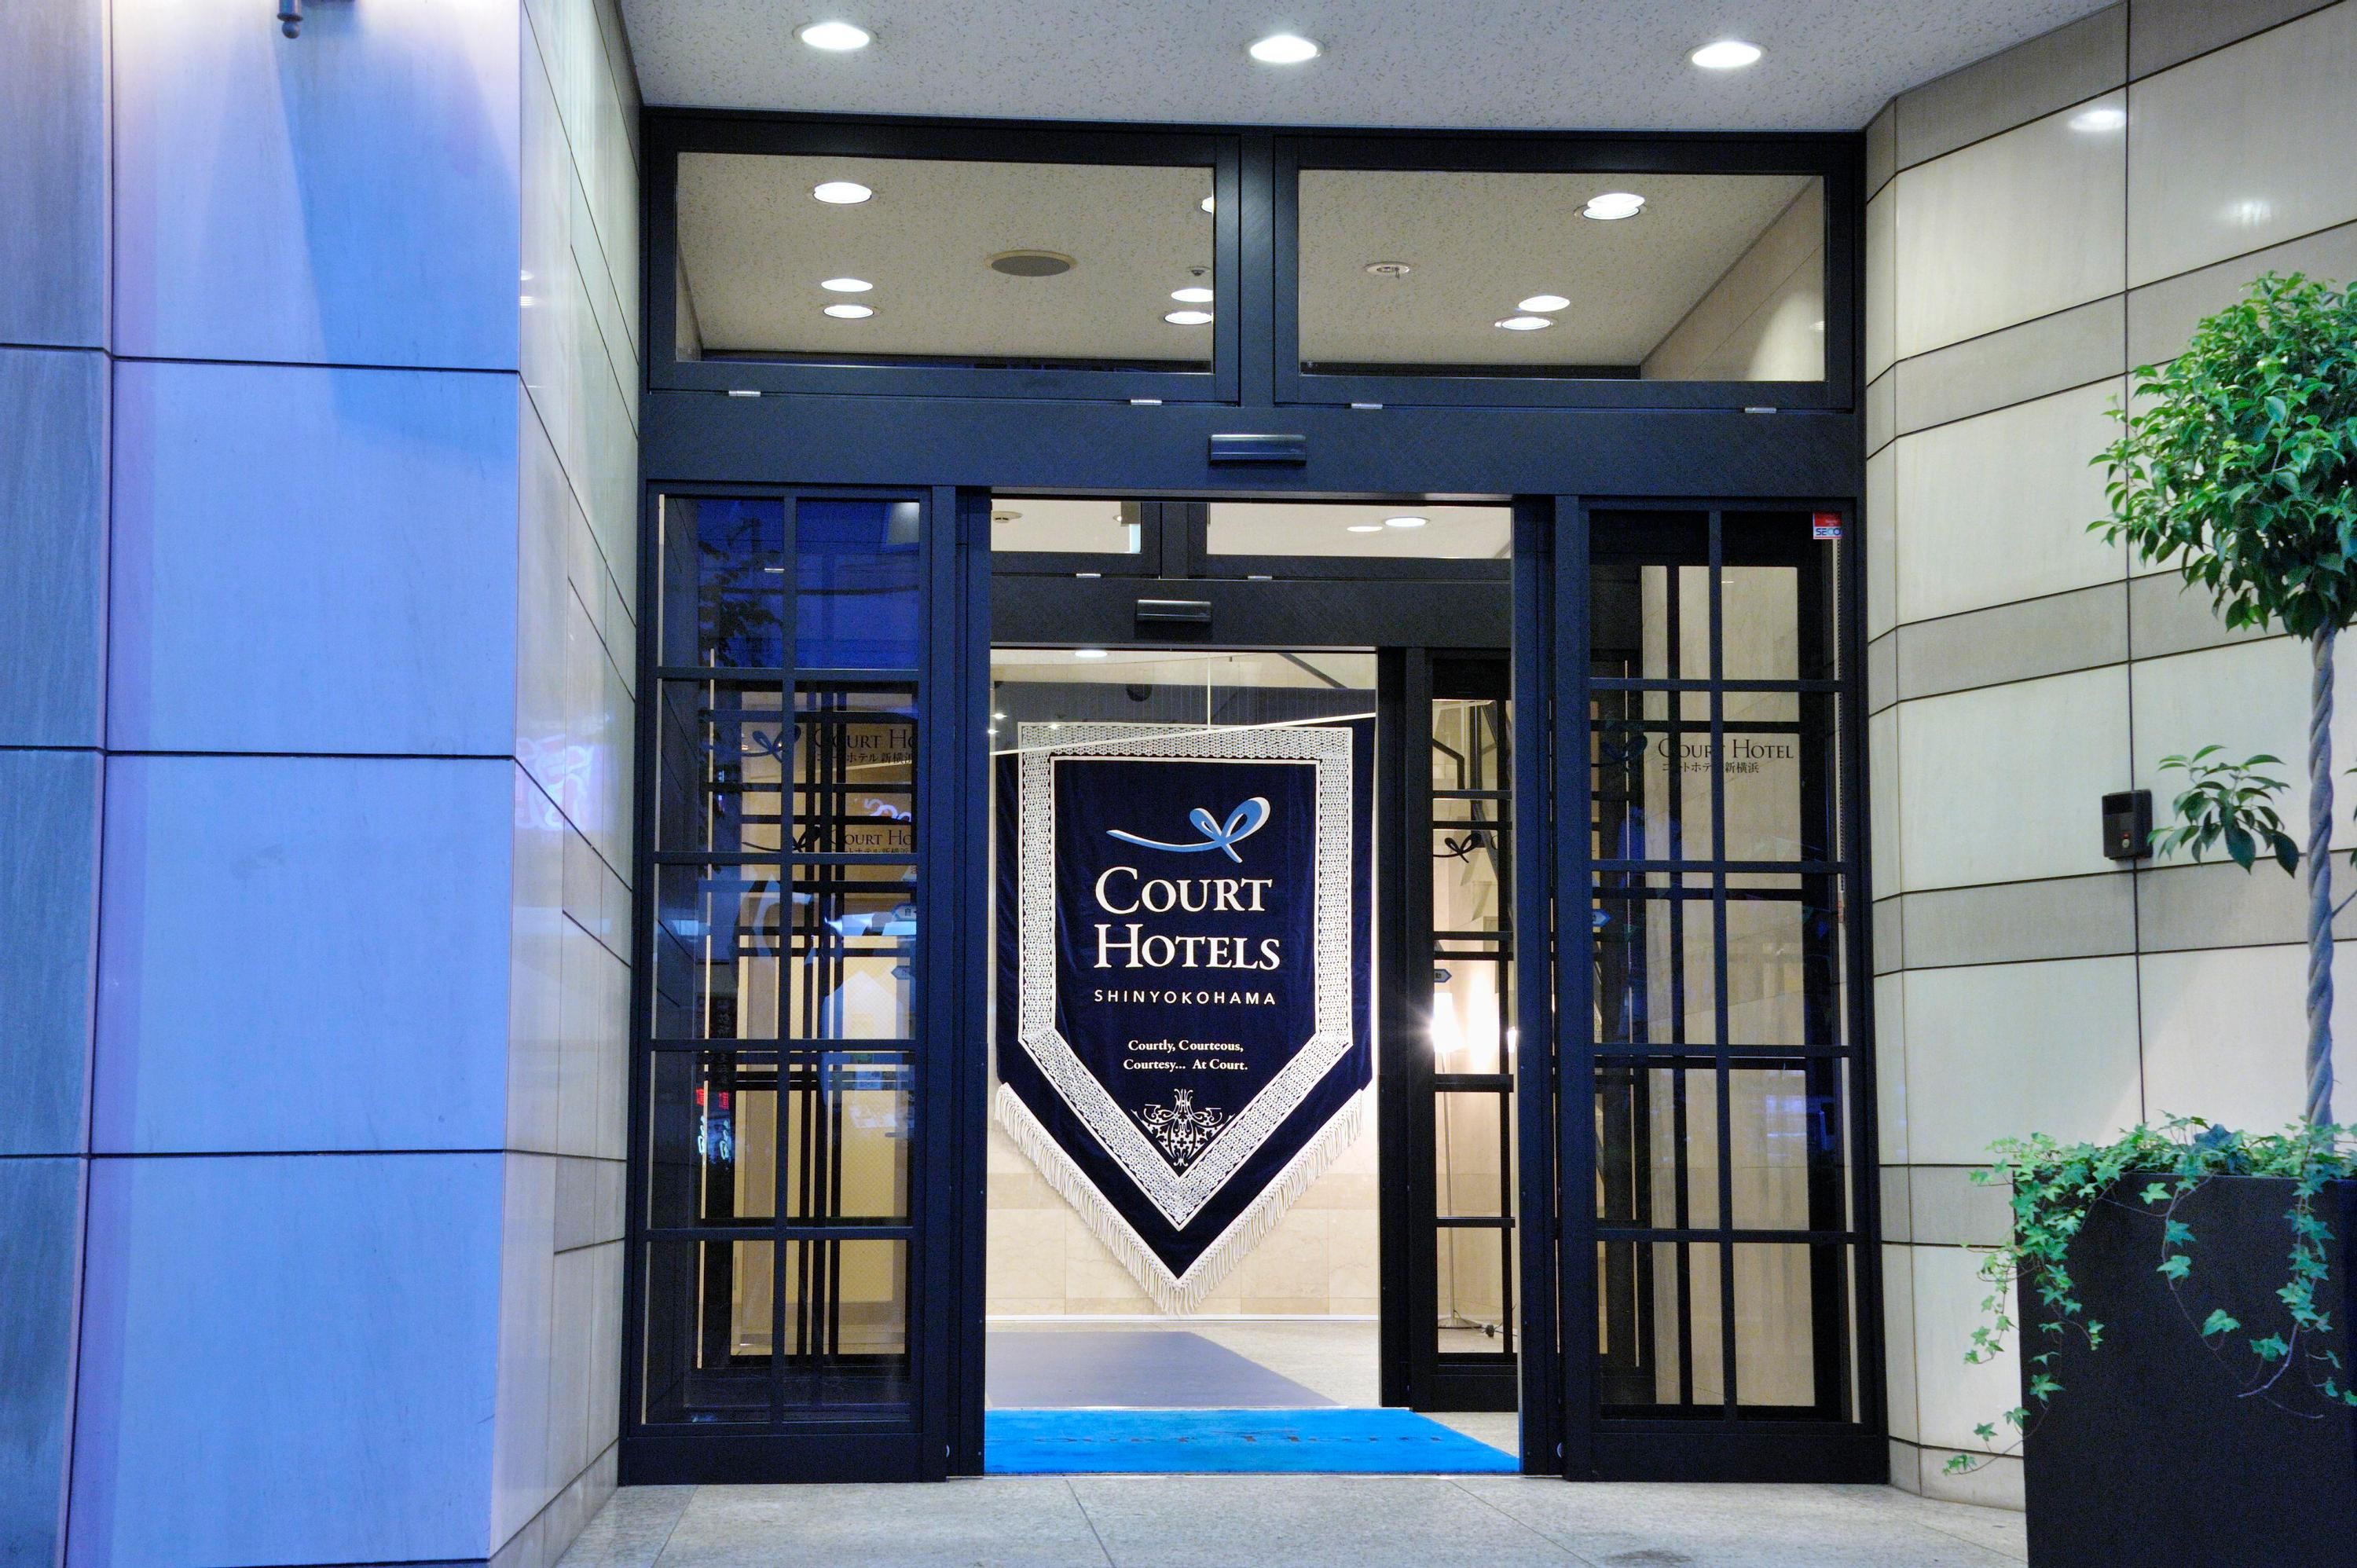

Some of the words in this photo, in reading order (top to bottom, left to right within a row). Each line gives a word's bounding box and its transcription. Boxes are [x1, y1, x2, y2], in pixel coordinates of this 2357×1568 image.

[1658, 738, 1725, 759] COUR
[1732, 738, 1794, 760] HOTEL
[1094, 866, 1273, 915] COURT
[1093, 923, 1281, 971] HOTELS
[1094, 989, 1276, 1005] SHINYOKOHAMA
[1127, 1039, 1176, 1053] Courtly,
[1178, 1039, 1244, 1053] Courteous,
[1123, 1058, 1186, 1072] Courtesy...
[1192, 1059, 1207, 1070] At
[1209, 1058, 1248, 1071] Court.
